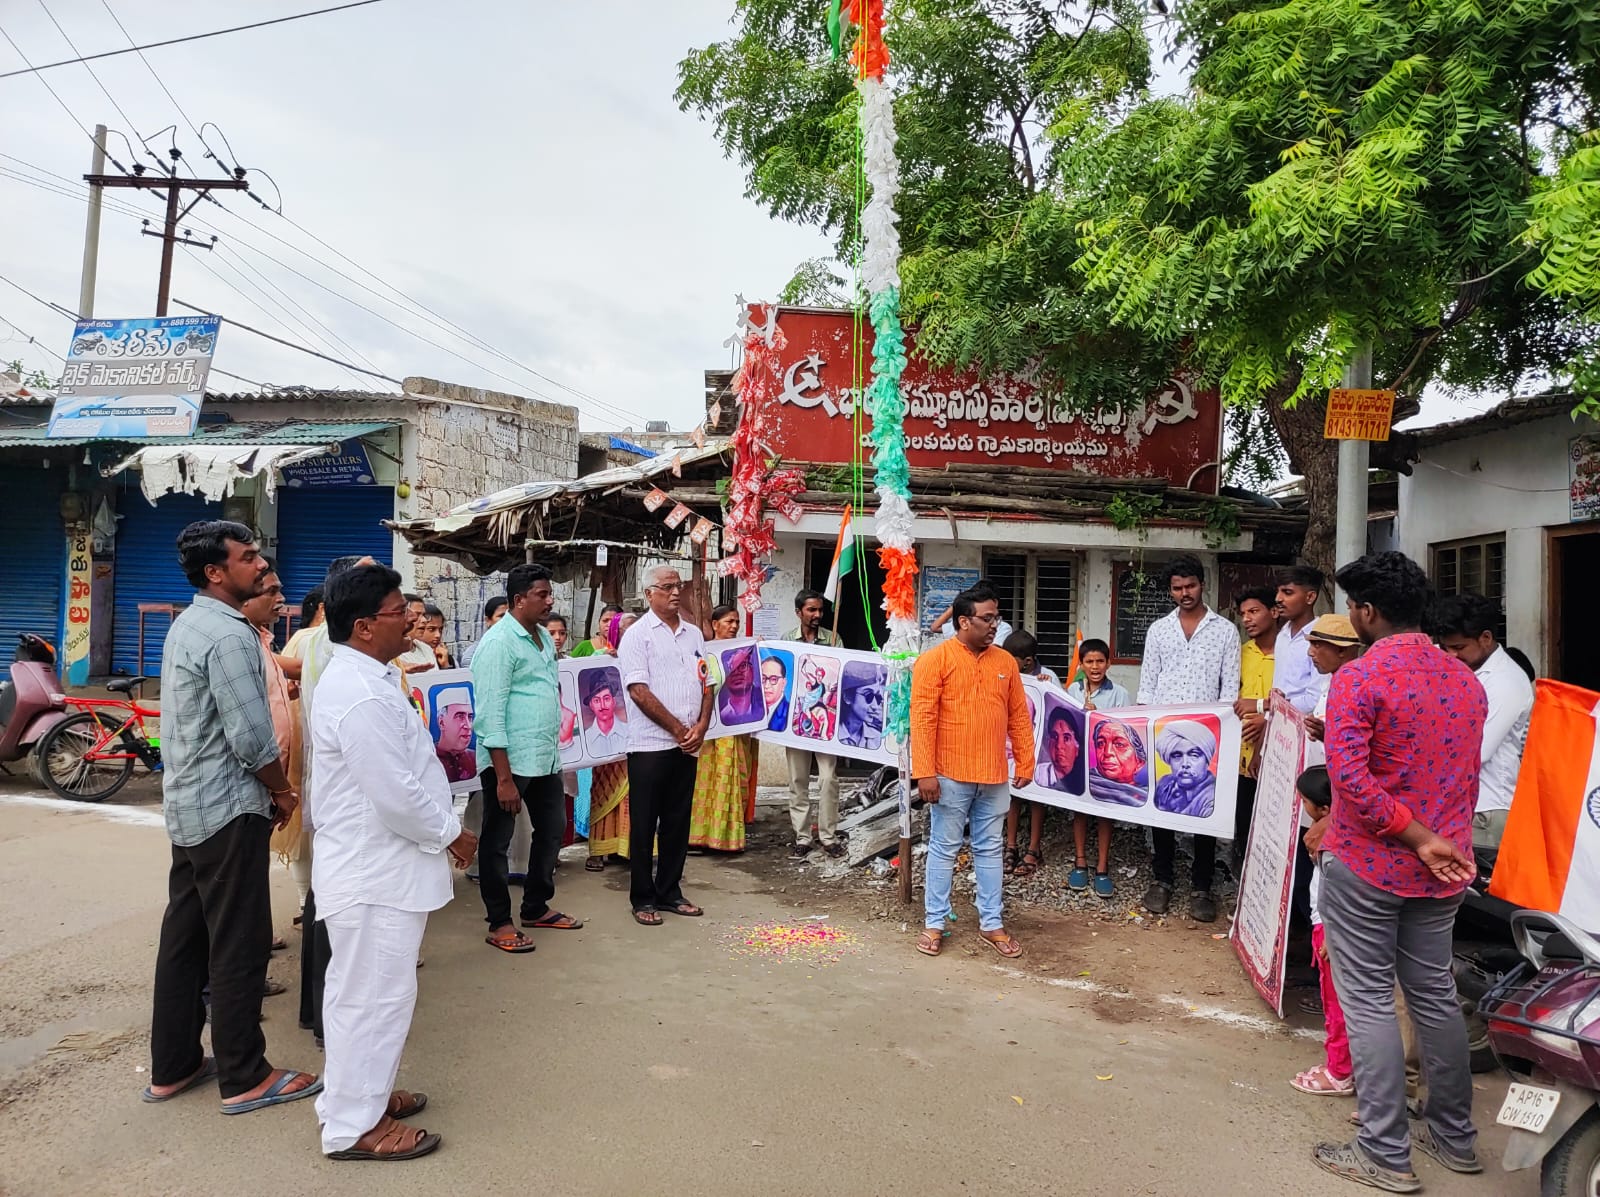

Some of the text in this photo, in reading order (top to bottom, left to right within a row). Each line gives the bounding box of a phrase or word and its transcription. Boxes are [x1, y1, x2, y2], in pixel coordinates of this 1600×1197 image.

[200, 316, 219, 325] 7215
[1327, 418, 1389, 439] 8143171717
[306, 455, 363, 467] SUPPLIERS
[288, 466, 331, 476] WHOLESALE
[339, 465, 364, 473] RETAIL
[1516, 1089, 1544, 1108] AP16
[1502, 1106, 1544, 1128] CW 1510
